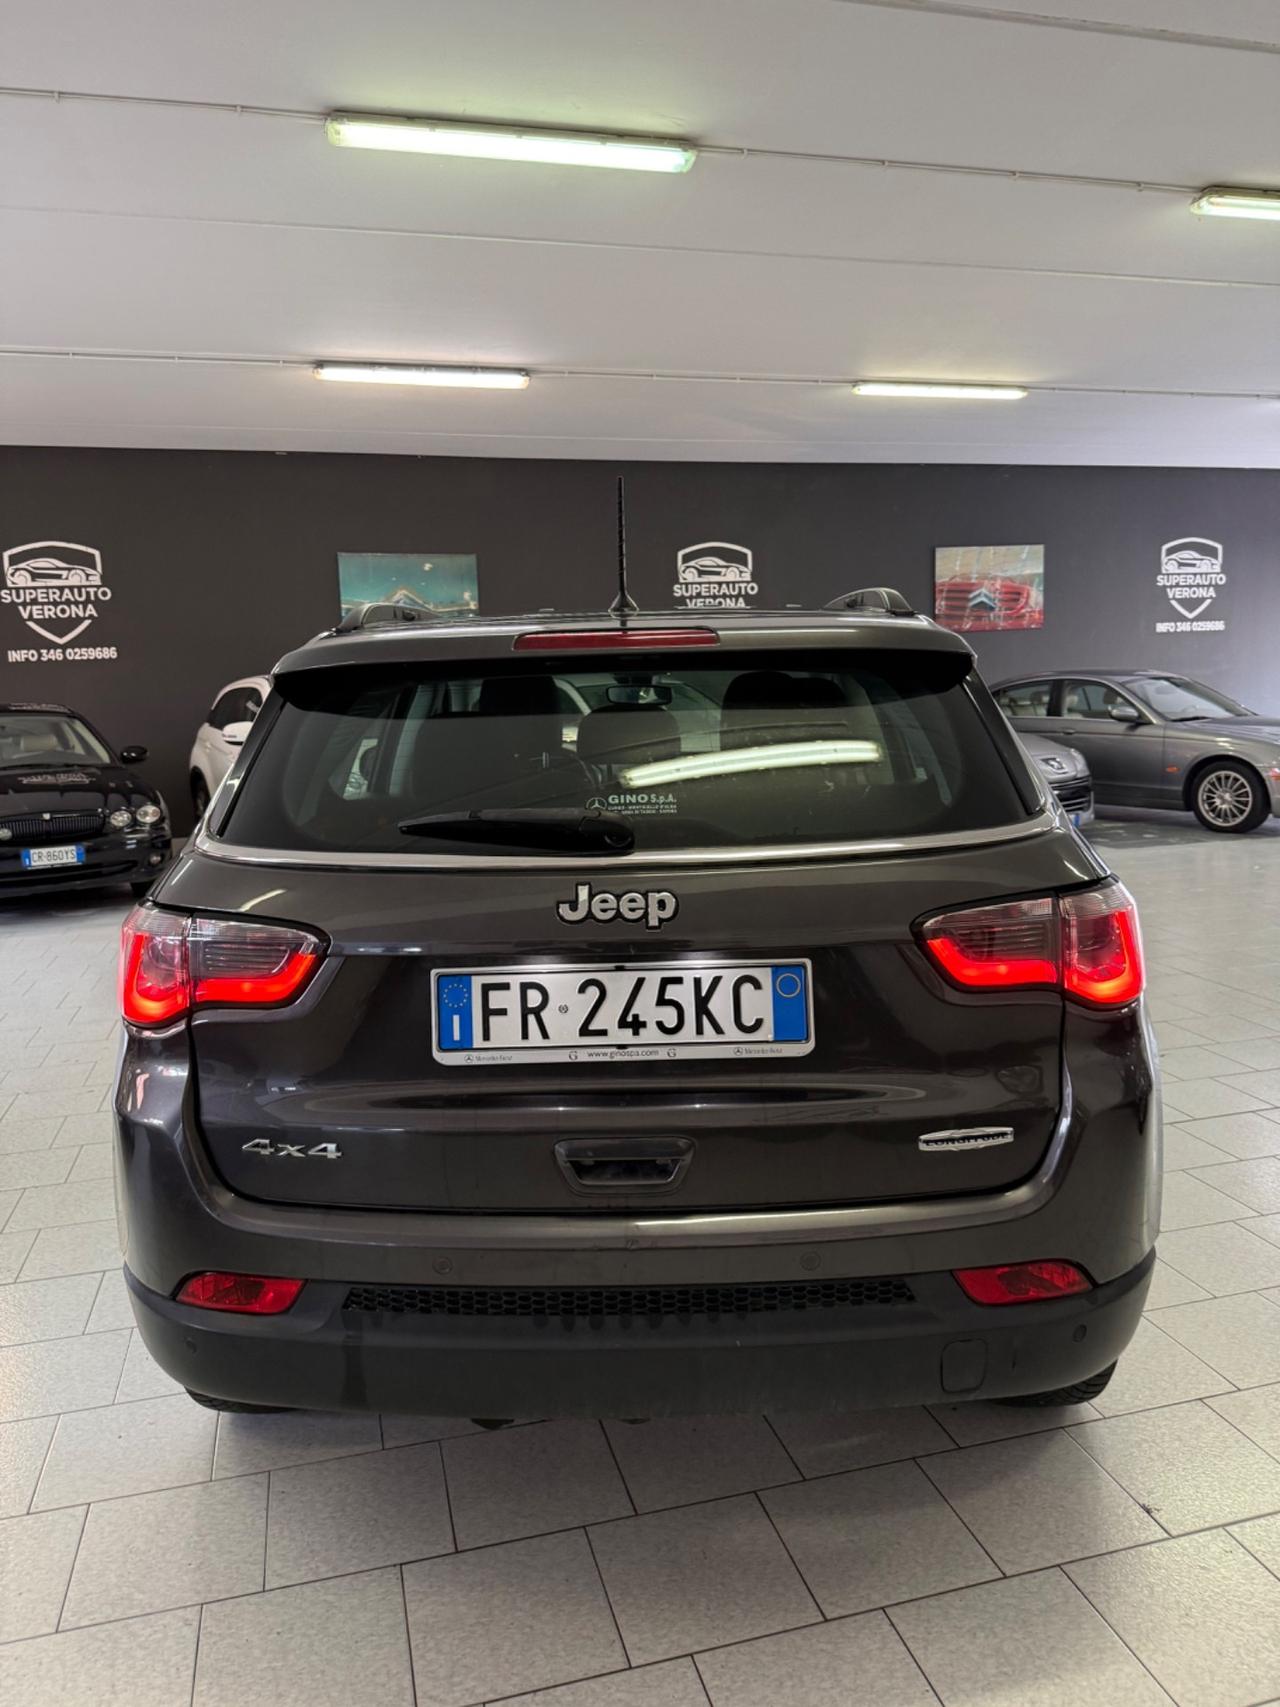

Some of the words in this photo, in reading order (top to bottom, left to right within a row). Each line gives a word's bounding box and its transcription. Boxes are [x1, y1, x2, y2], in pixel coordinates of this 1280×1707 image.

[1156, 574, 1226, 586] SUPERAUTO
[0, 587, 112, 603] SUPERAUTO
[671, 582, 758, 597] SUPERAUTO
[1166, 586, 1216, 599] VERONA
[18, 604, 98, 619] VERONA
[8, 650, 38, 662] INFO
[40, 649, 63, 661] 346
[65, 647, 118, 660] 0259686
[607, 793, 649, 804] GINO
[557, 883, 677, 928] Jeep
[481, 981, 550, 1042] FR
[576, 974, 764, 1038] 245KC
[241, 1138, 342, 1159] 4x4
